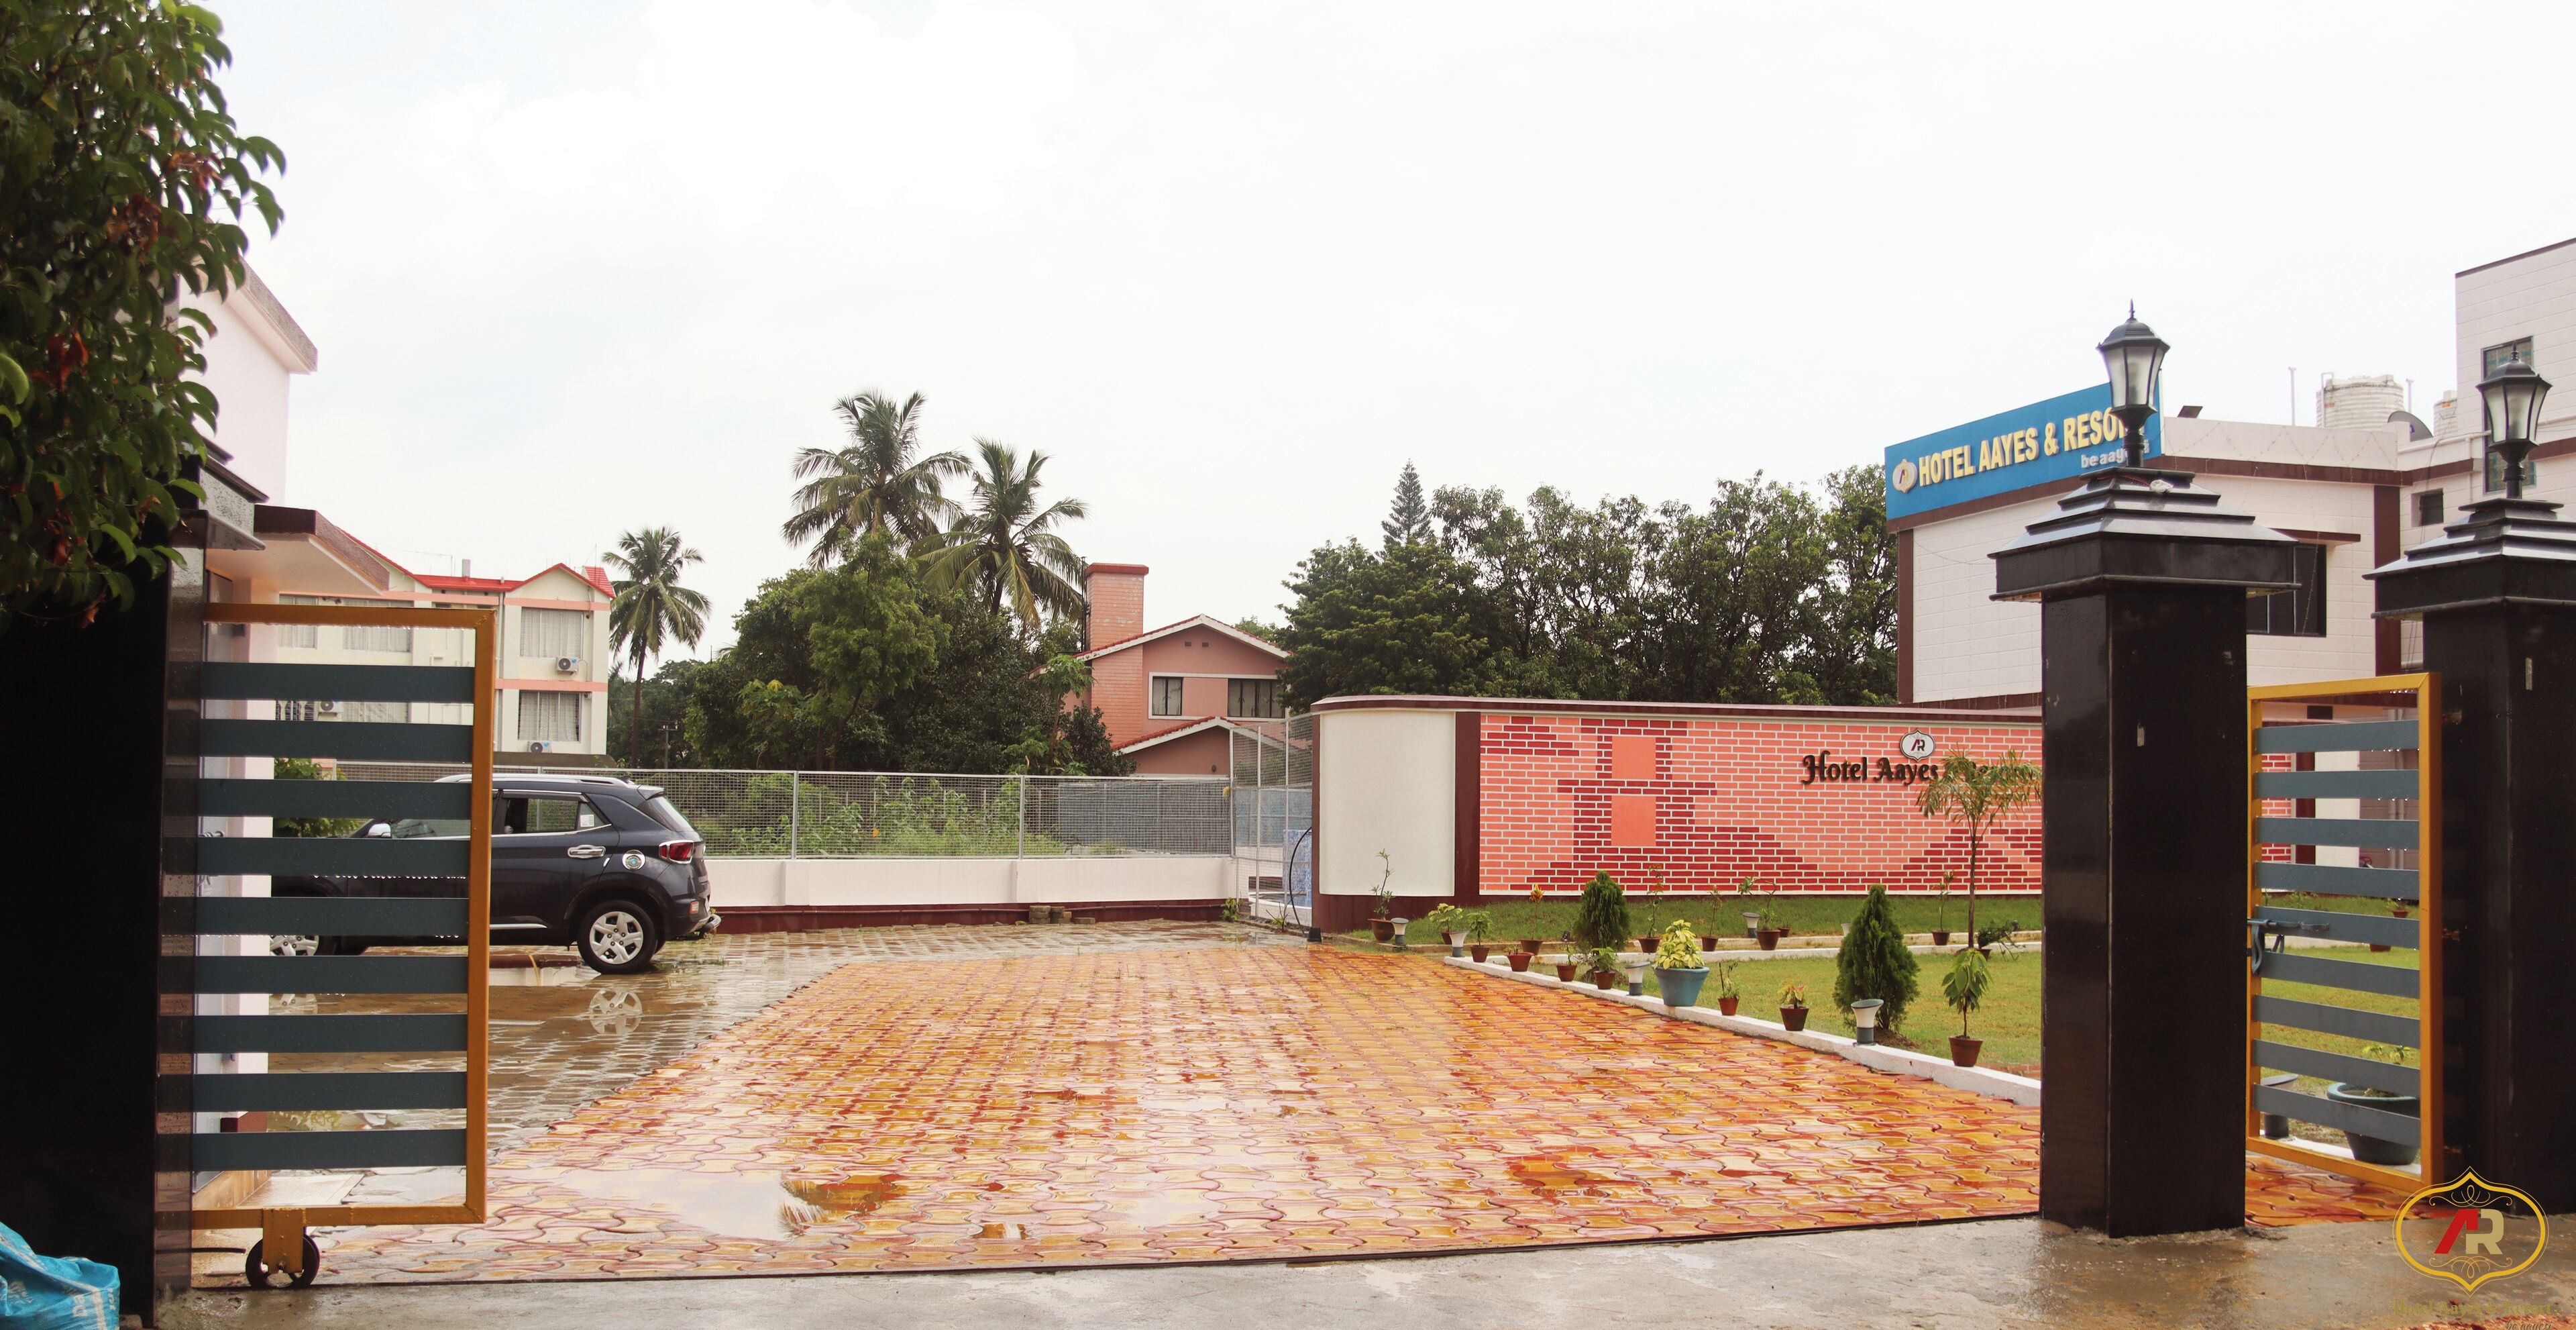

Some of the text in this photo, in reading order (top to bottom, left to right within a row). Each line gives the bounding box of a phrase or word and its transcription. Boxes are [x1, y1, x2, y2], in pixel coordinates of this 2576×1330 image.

[1919, 407, 2145, 487] HOTEL AAYES & RESO
[2082, 454, 2099, 468] be
[1802, 750, 1867, 784] Hotel
[1874, 757, 1938, 786] Aayes
